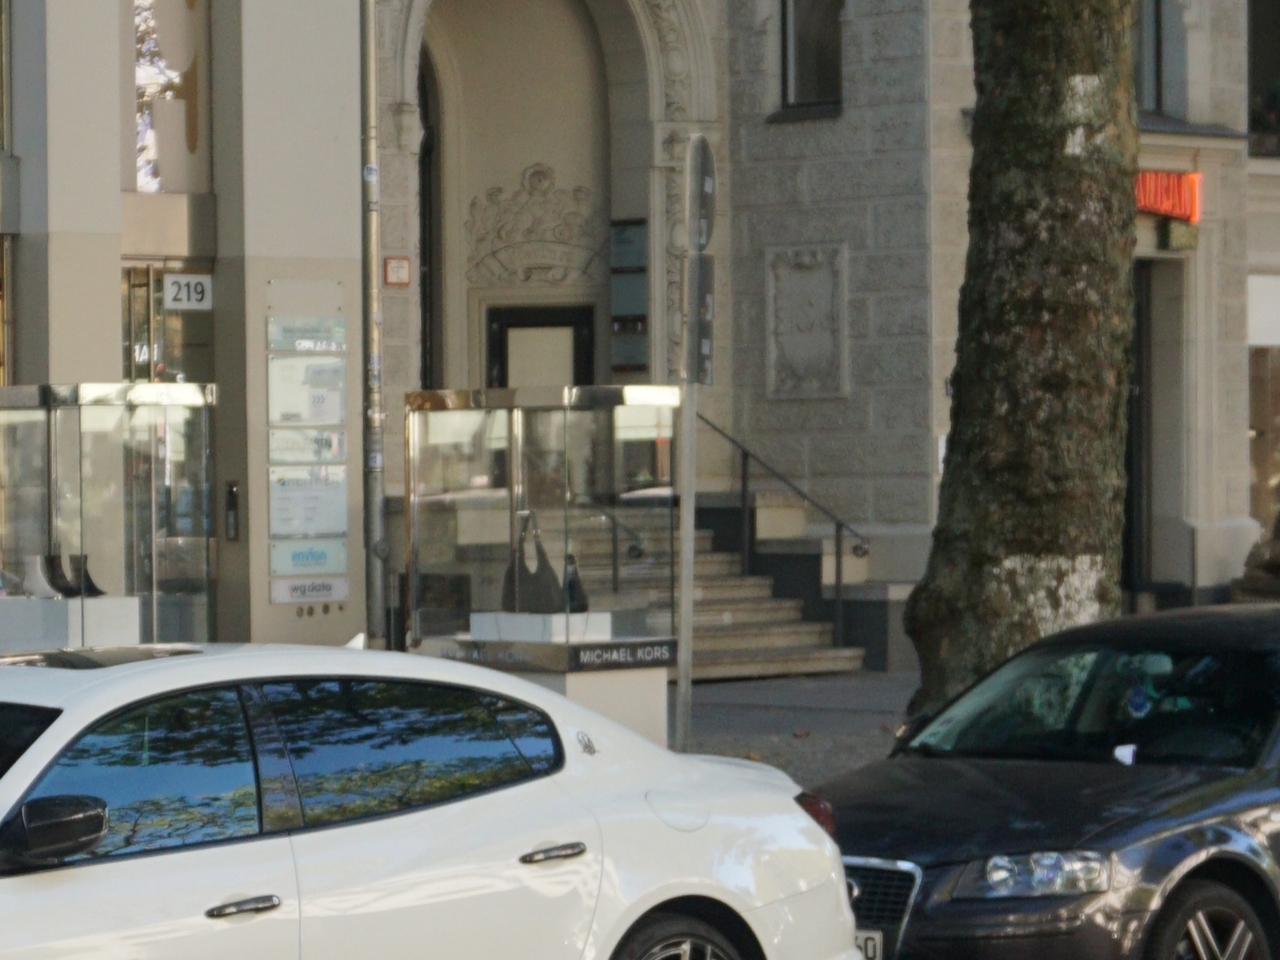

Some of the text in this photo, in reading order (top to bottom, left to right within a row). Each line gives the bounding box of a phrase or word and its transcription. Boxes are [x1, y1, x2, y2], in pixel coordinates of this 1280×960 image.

[171, 281, 205, 303] 219
[580, 646, 669, 663] MICHAEL KORS
